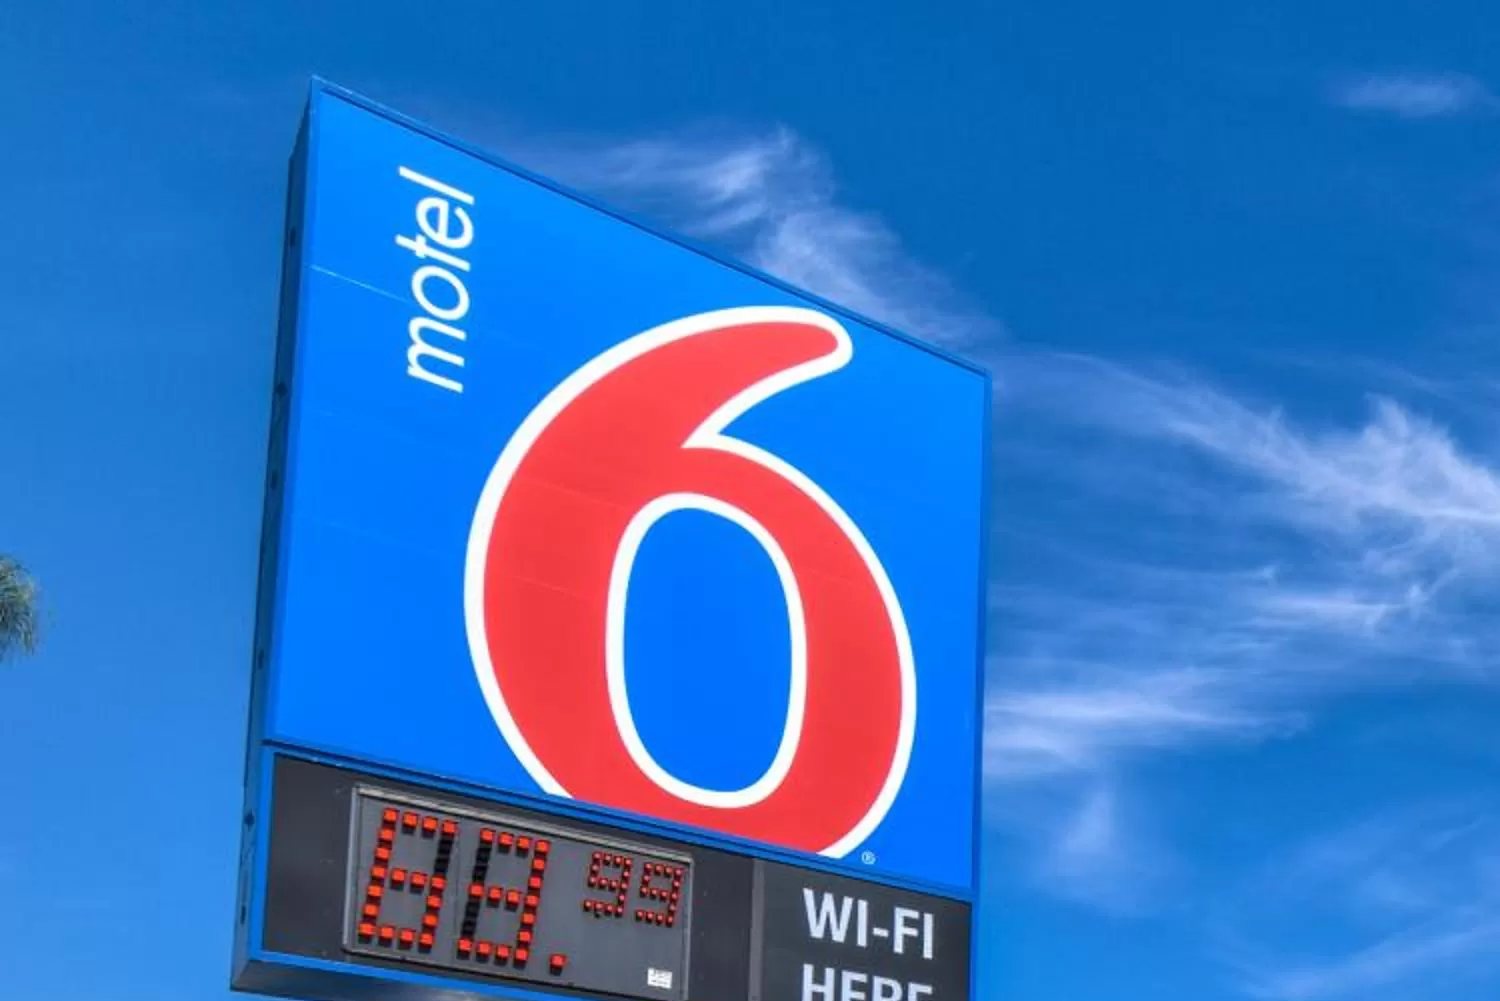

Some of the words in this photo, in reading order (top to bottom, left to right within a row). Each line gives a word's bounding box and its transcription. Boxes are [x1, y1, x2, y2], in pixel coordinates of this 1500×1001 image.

[396, 166, 475, 392] motel
[463, 305, 918, 858] 6
[802, 887, 934, 960] WI-FI
